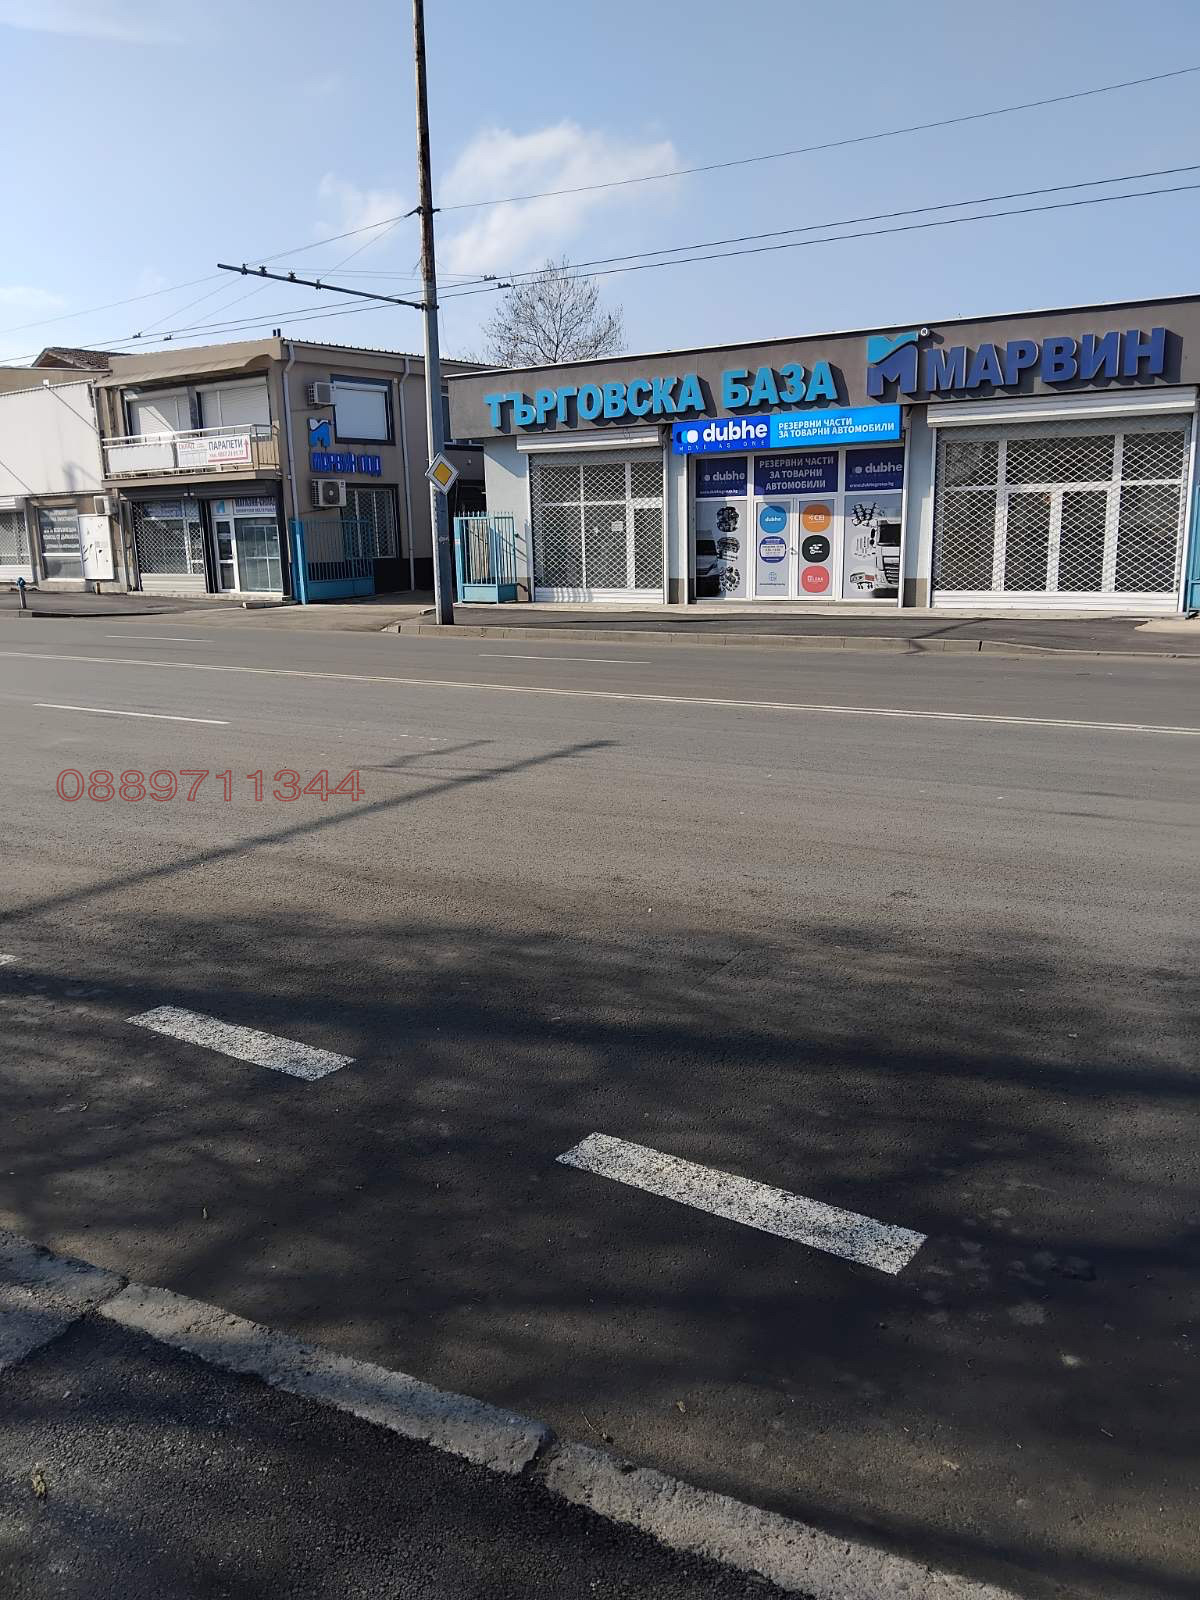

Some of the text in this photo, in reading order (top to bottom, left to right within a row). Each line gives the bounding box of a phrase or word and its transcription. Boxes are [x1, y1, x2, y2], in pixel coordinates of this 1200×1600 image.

[926, 327, 1167, 392] МАРВИН
[484, 361, 839, 429] ТЪРГОВСКА БАЗА
[703, 419, 768, 442] dubhe
[778, 417, 853, 431] РЕЗЕРВНИ ЧАСТИ
[778, 423, 895, 439] ЗА ТОВАРНИ АВТОМОБИЛИ
[208, 439, 243, 451] ПАРАПЕТИ
[759, 456, 834, 468] РЕЗЕРВНИ ЧАСТИ
[865, 461, 903, 474] dubhe
[712, 470, 745, 481] dubhe
[769, 468, 823, 479] ЗА ТОВАРНИ
[766, 479, 826, 491] АВТОМОБИЛИ
